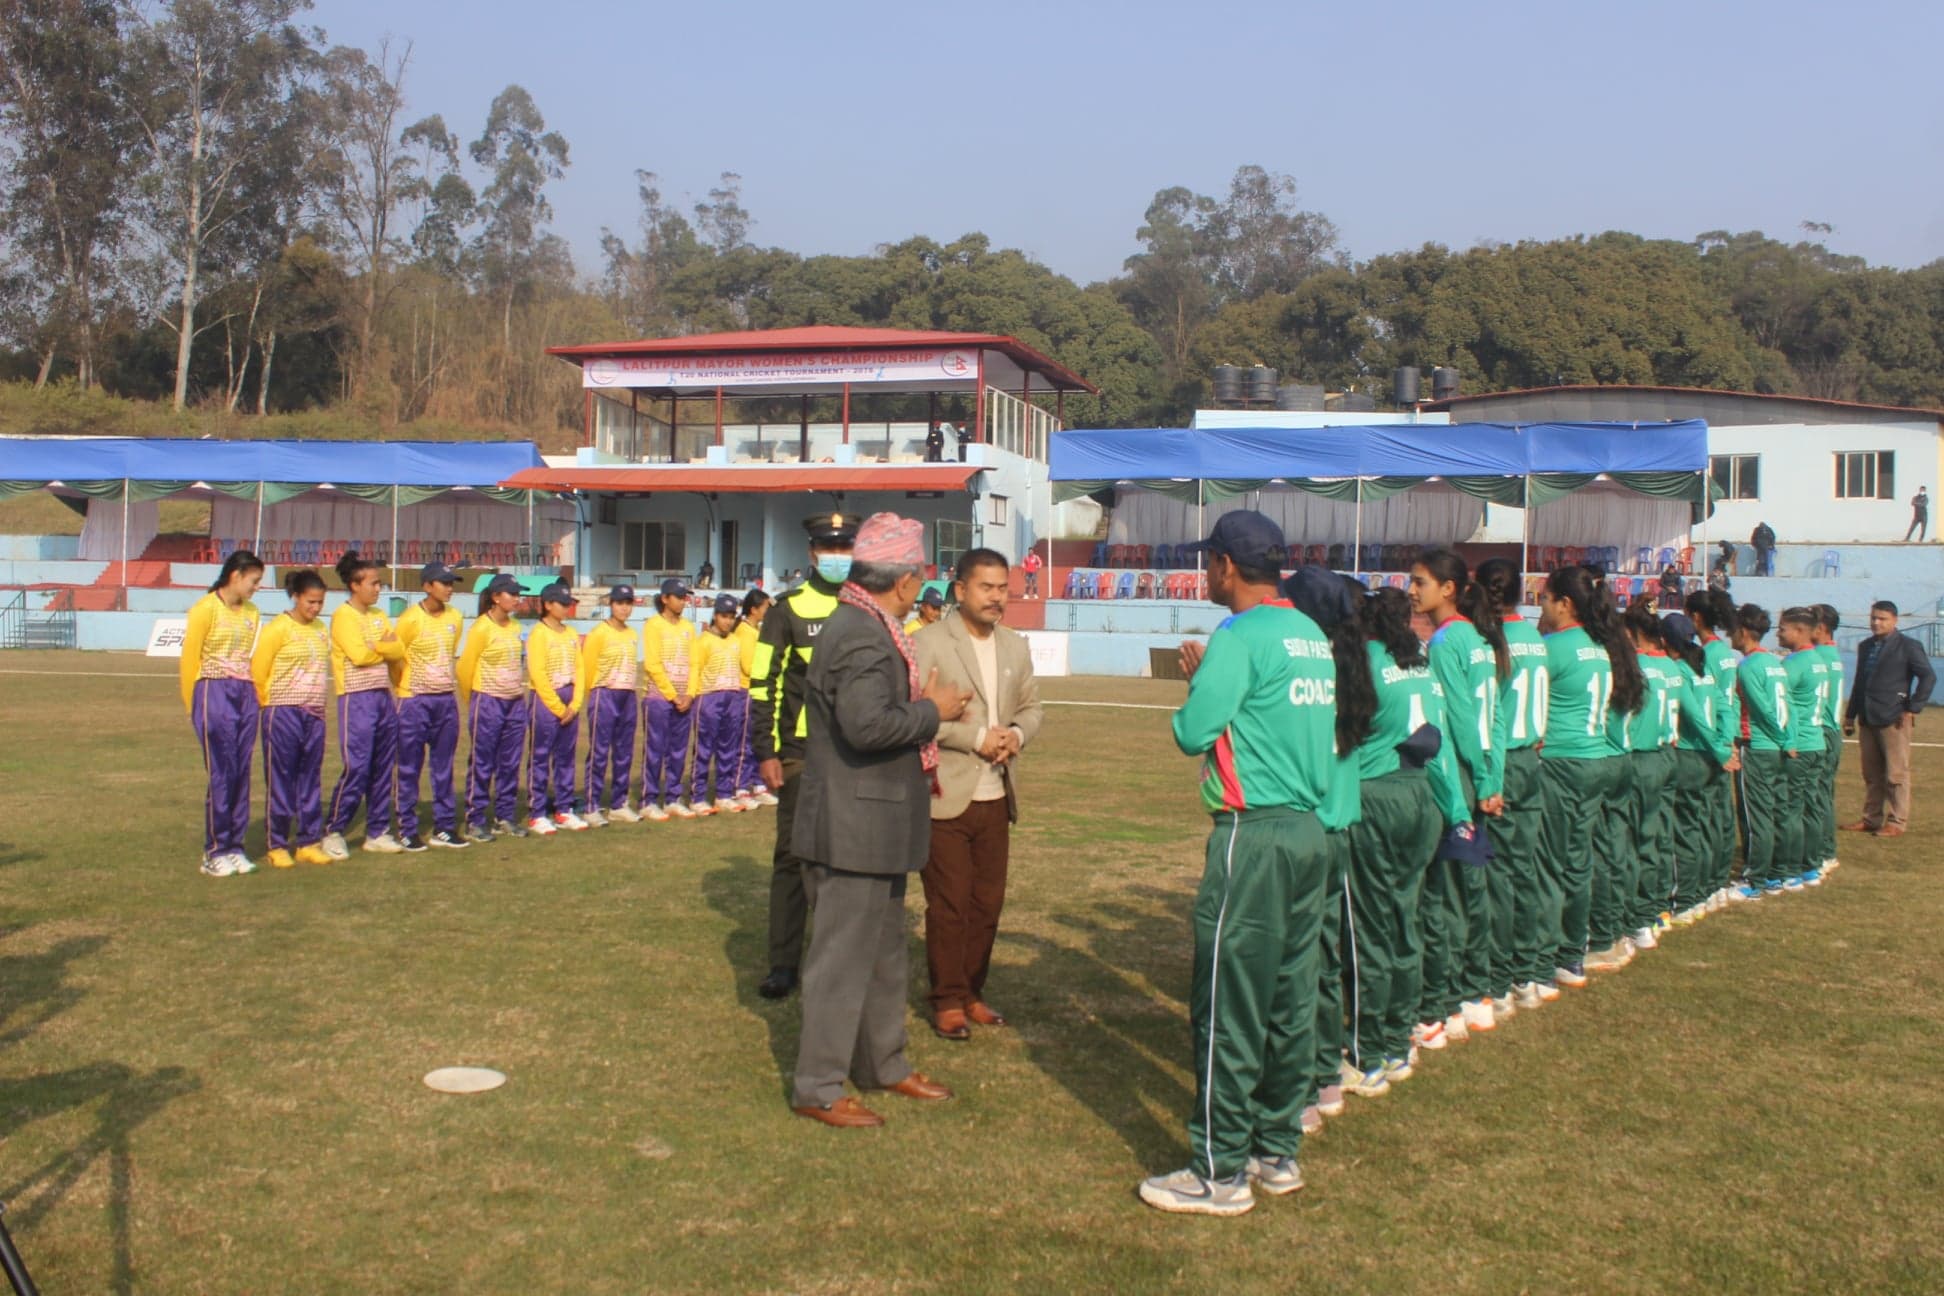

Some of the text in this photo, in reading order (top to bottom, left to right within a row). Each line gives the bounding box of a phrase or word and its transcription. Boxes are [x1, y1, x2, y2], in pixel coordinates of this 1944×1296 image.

[623, 352, 934, 370] LALITPUR MAYOR WOMEN'S CHAMPIONSHIP
[785, 368, 844, 376] TOURNAMENT
[1511, 665, 1550, 738] 10
